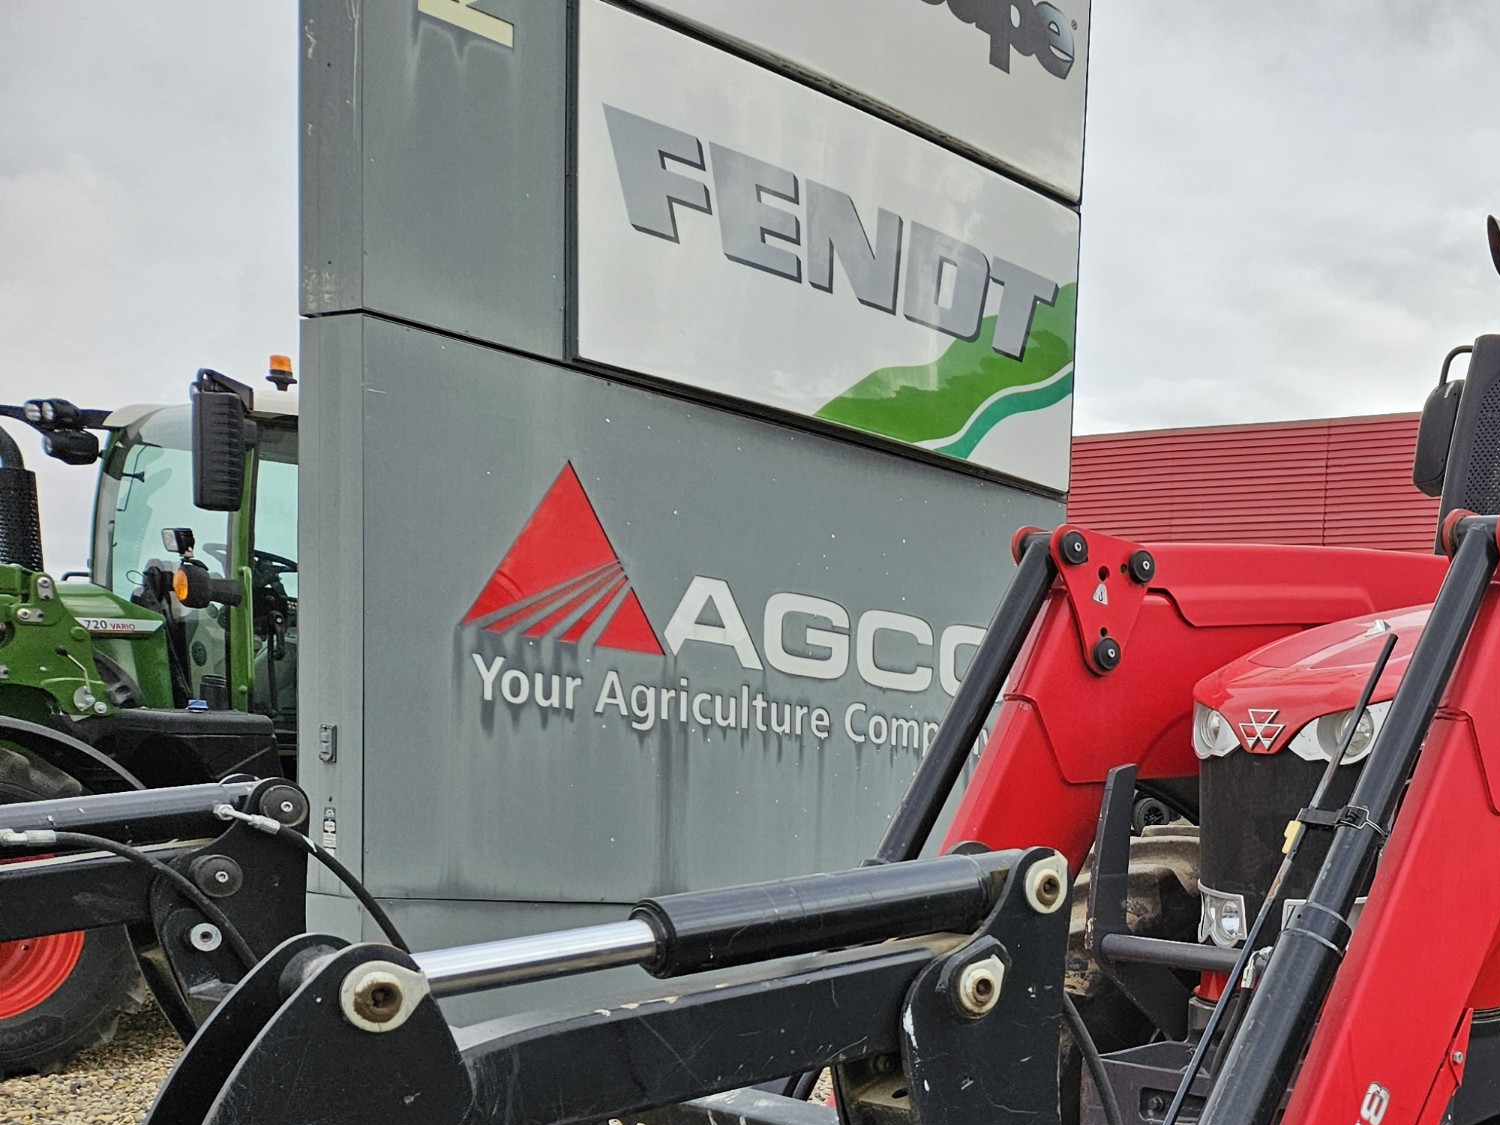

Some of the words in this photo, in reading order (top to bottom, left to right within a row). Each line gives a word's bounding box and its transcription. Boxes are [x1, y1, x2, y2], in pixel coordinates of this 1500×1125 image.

[602, 102, 1059, 362] FENDT
[83, 619, 108, 630] 720
[471, 652, 584, 711] Your
[594, 669, 831, 739] Agriculture
